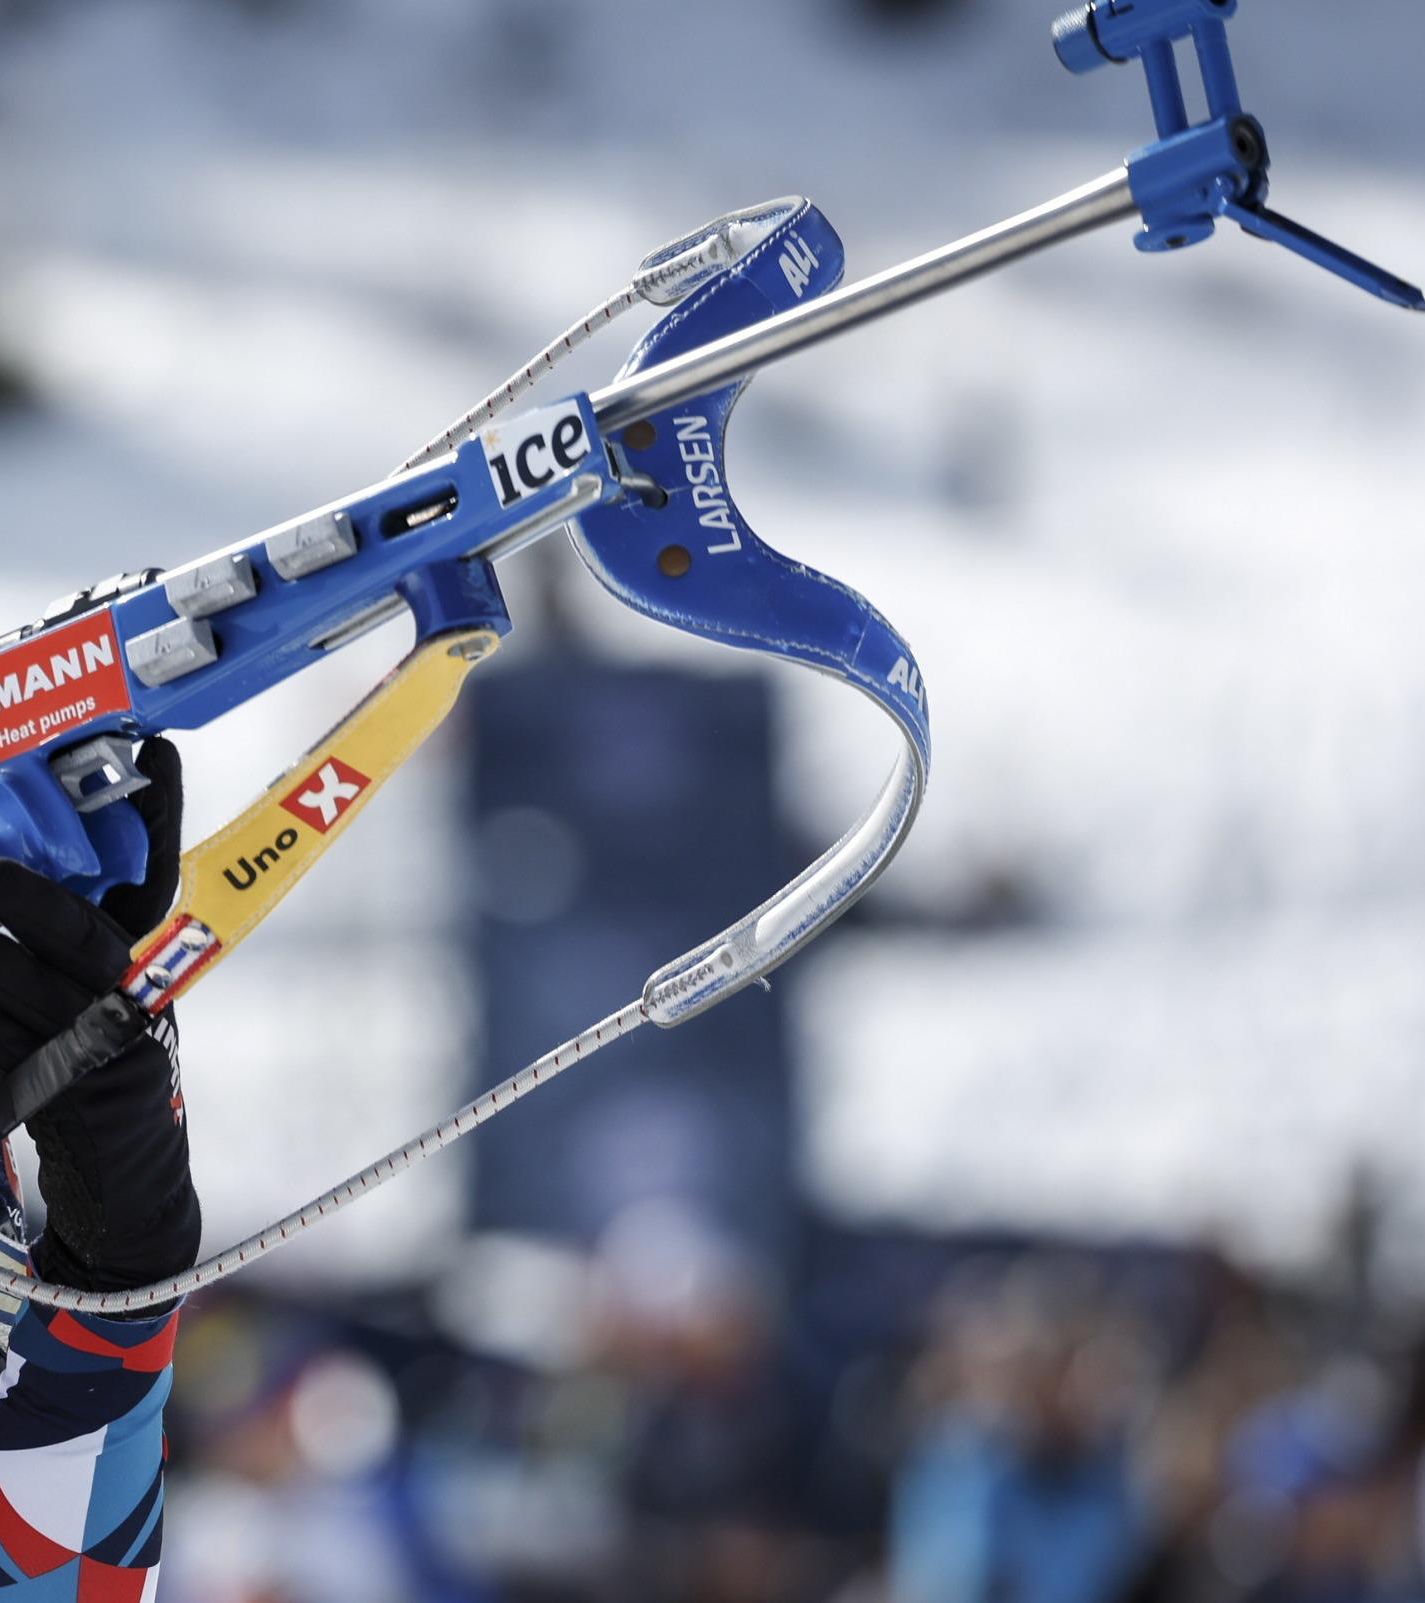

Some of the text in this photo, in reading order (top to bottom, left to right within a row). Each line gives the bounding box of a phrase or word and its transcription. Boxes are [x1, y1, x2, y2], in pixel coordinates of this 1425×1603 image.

[486, 414, 589, 506] ice
[673, 415, 743, 555] LARSEN
[39, 696, 96, 735] pumps
[222, 762, 360, 891] Uno X
